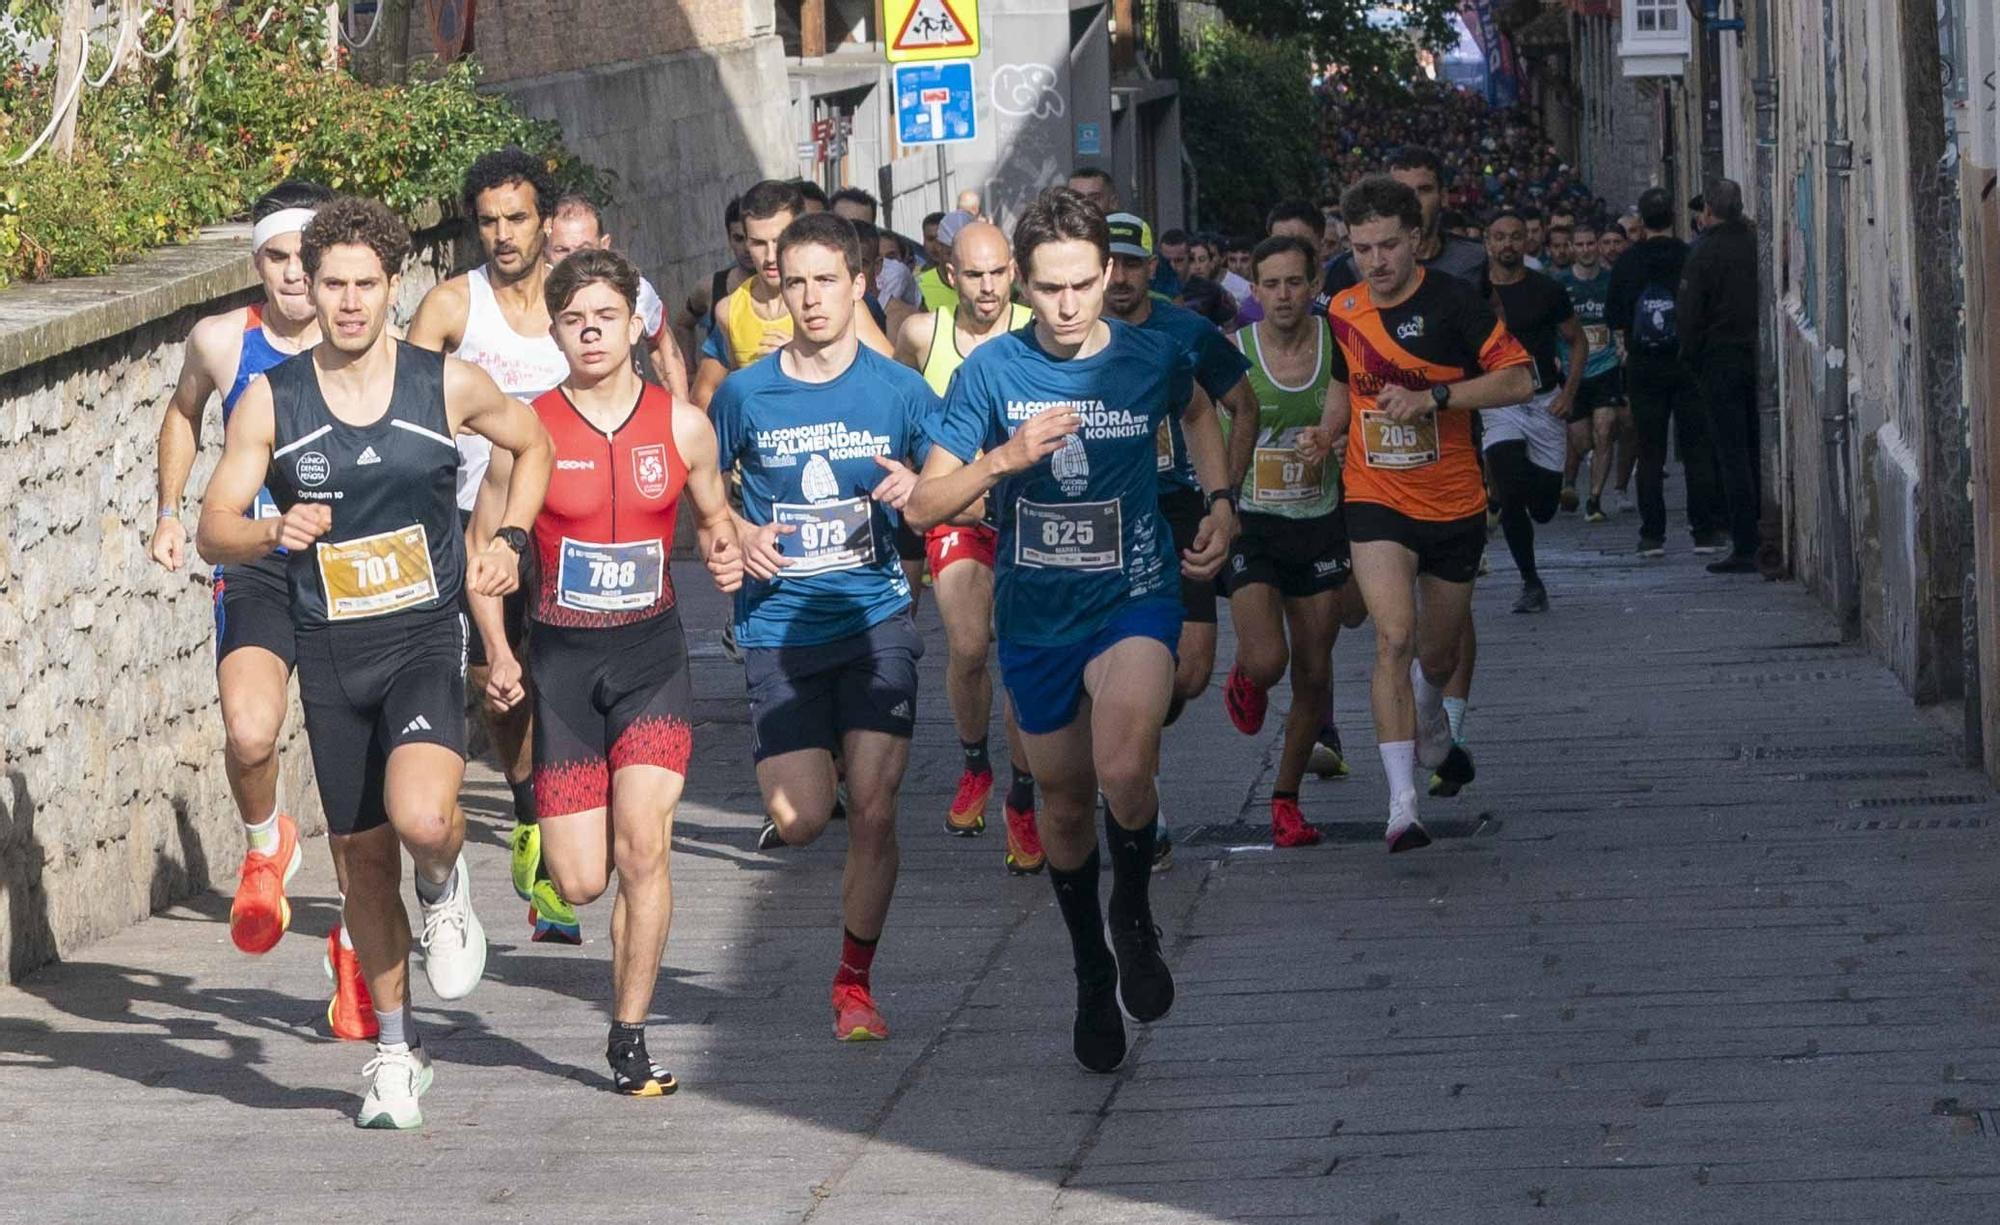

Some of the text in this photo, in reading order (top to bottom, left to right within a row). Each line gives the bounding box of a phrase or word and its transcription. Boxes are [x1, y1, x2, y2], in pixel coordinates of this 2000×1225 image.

[1008, 400, 1024, 412] LA
[757, 421, 847, 442] LA CONQUISTA
[1085, 423, 1149, 440] KONKISTA
[1379, 424, 1417, 447] 205
[776, 430, 874, 456] ALMENDRA
[828, 443, 892, 460] KONKISTA
[301, 464, 325, 473] DENTAL
[1282, 462, 1305, 483] 67
[334, 491, 344, 499] 10
[800, 519, 847, 550] 973
[1042, 519, 1094, 546] 825
[351, 551, 400, 589] 701
[588, 560, 637, 589] 788
